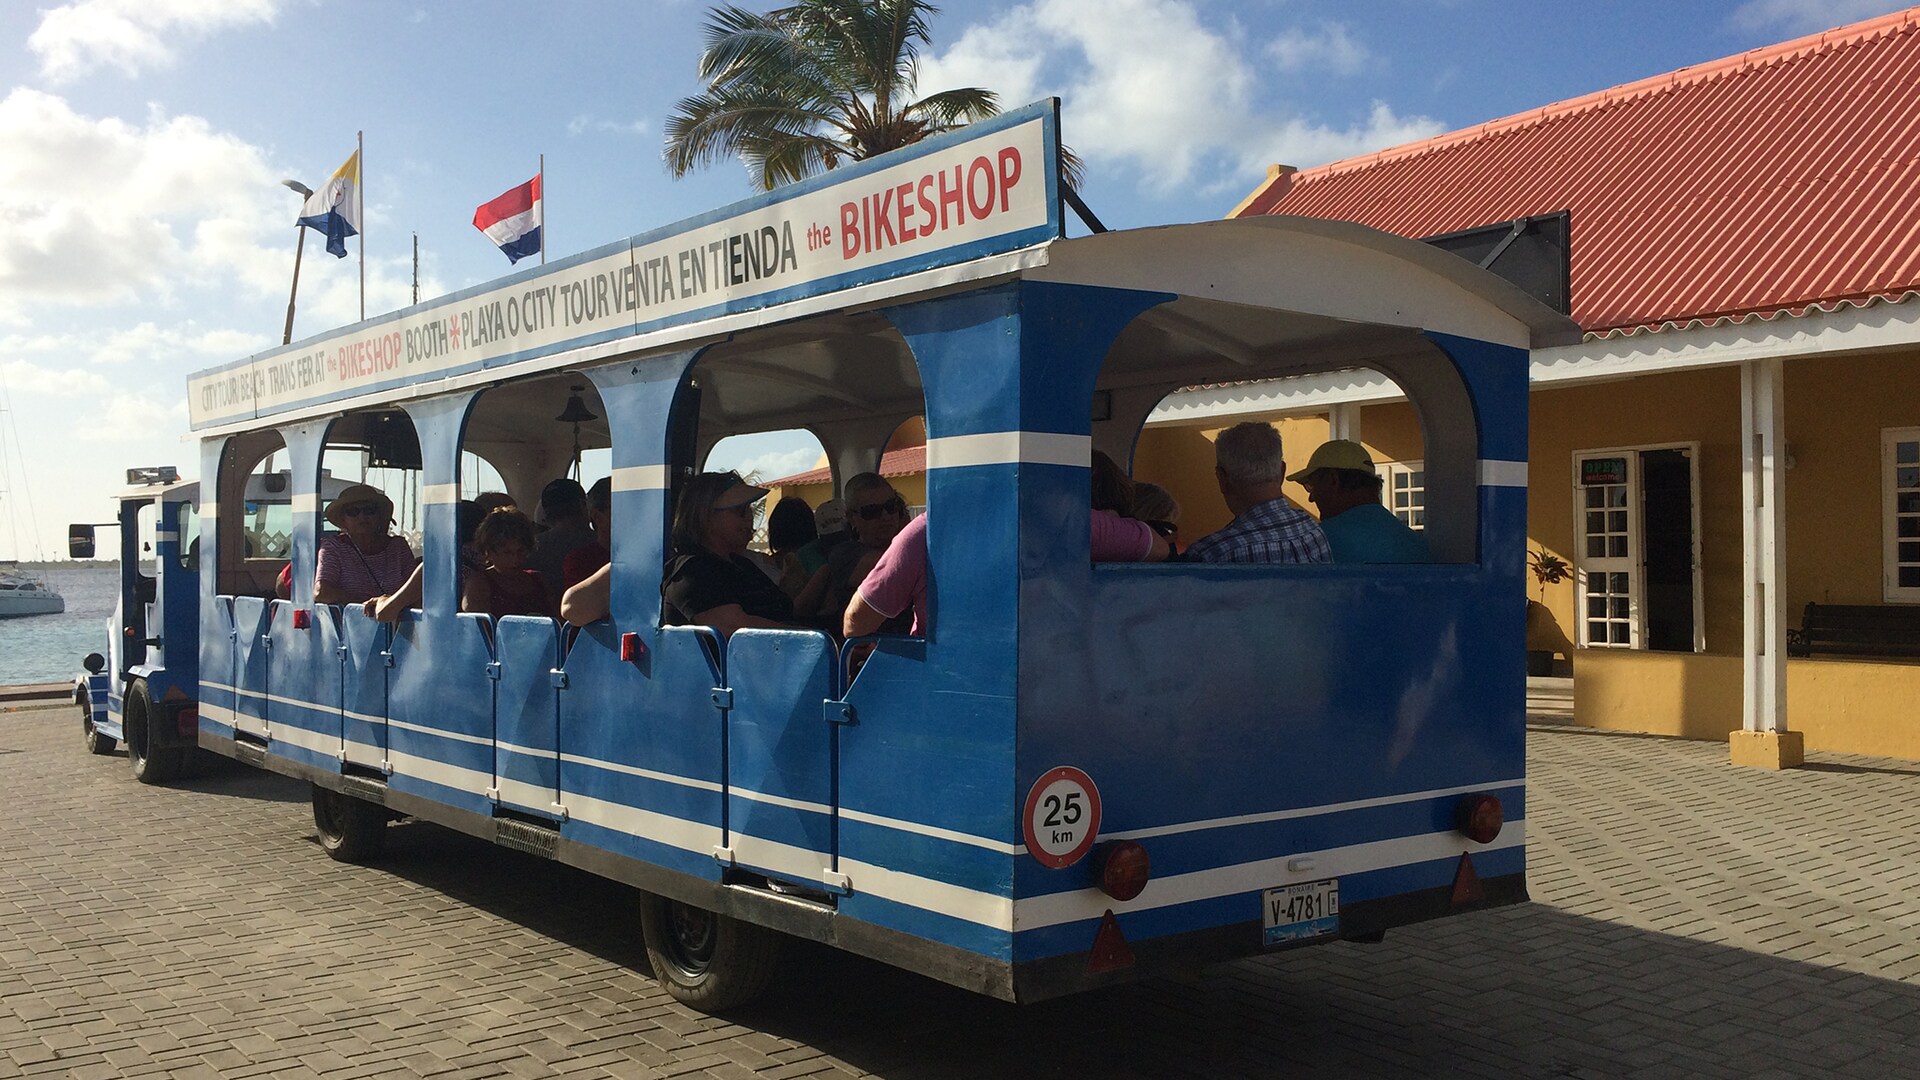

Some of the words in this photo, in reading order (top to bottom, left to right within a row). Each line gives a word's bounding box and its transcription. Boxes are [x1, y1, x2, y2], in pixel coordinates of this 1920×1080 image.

[202, 383, 219, 411] CITY
[327, 355, 337, 373] the
[338, 331, 402, 381] BIKESHOP
[406, 318, 449, 364] BOOTH
[461, 301, 506, 350] PLAYA
[507, 297, 519, 337] O
[522, 285, 557, 333] CITY
[560, 273, 610, 327] TOUR
[610, 255, 675, 314] VENTA
[679, 246, 707, 299] EN
[709, 220, 798, 290] TIENDA
[806, 222, 831, 252] the
[840, 146, 1022, 260] BIKESHOP
[1586, 461, 1620, 473] OPEN
[1043, 792, 1082, 827] 25
[1052, 830, 1073, 844] km
[1288, 884, 1315, 895] BONAIRE
[1271, 893, 1322, 925] V-4781
